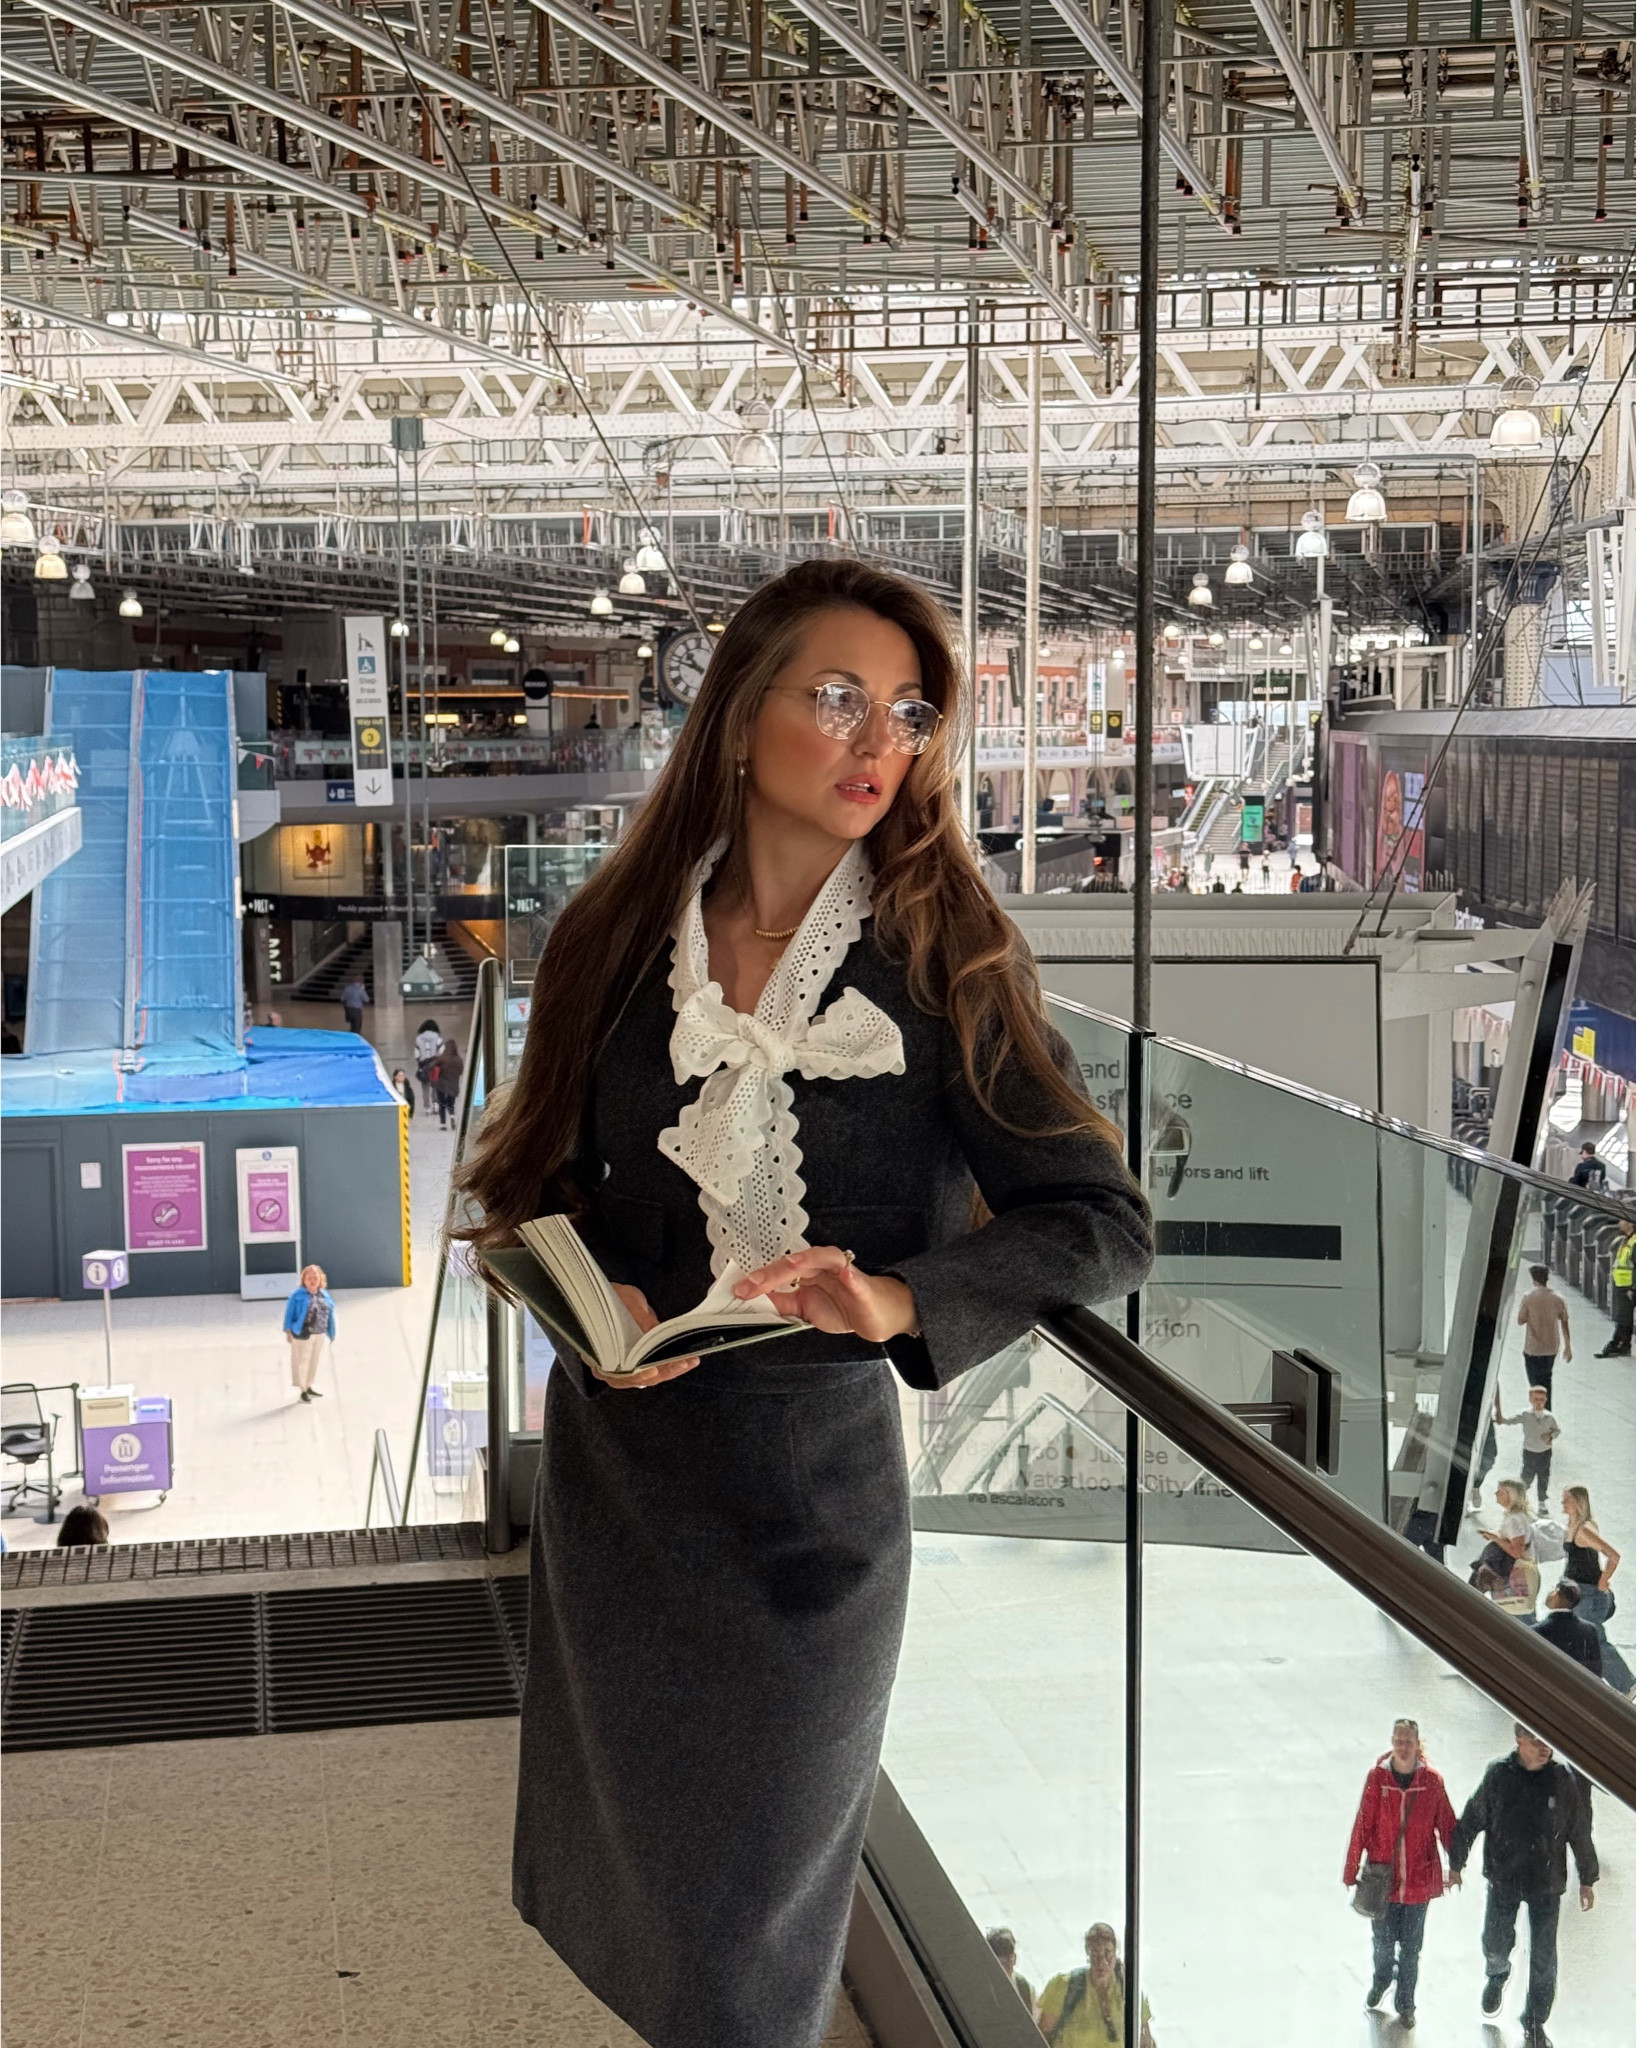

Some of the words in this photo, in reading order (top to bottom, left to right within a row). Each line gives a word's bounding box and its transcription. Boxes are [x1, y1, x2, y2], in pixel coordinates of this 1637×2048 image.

[366, 732, 374, 743] 3
[253, 898, 269, 914] PRET
[516, 897, 535, 913] PRET
[1080, 1059, 1120, 1079] and
[1213, 1166, 1244, 1180] and
[1249, 1166, 1270, 1181] lift
[103, 1462, 150, 1474] Passenger
[99, 1474, 156, 1486] Information
[1145, 1474, 1184, 1498] City
[1193, 1477, 1234, 1498] line
[990, 1494, 1066, 1508] escalators
